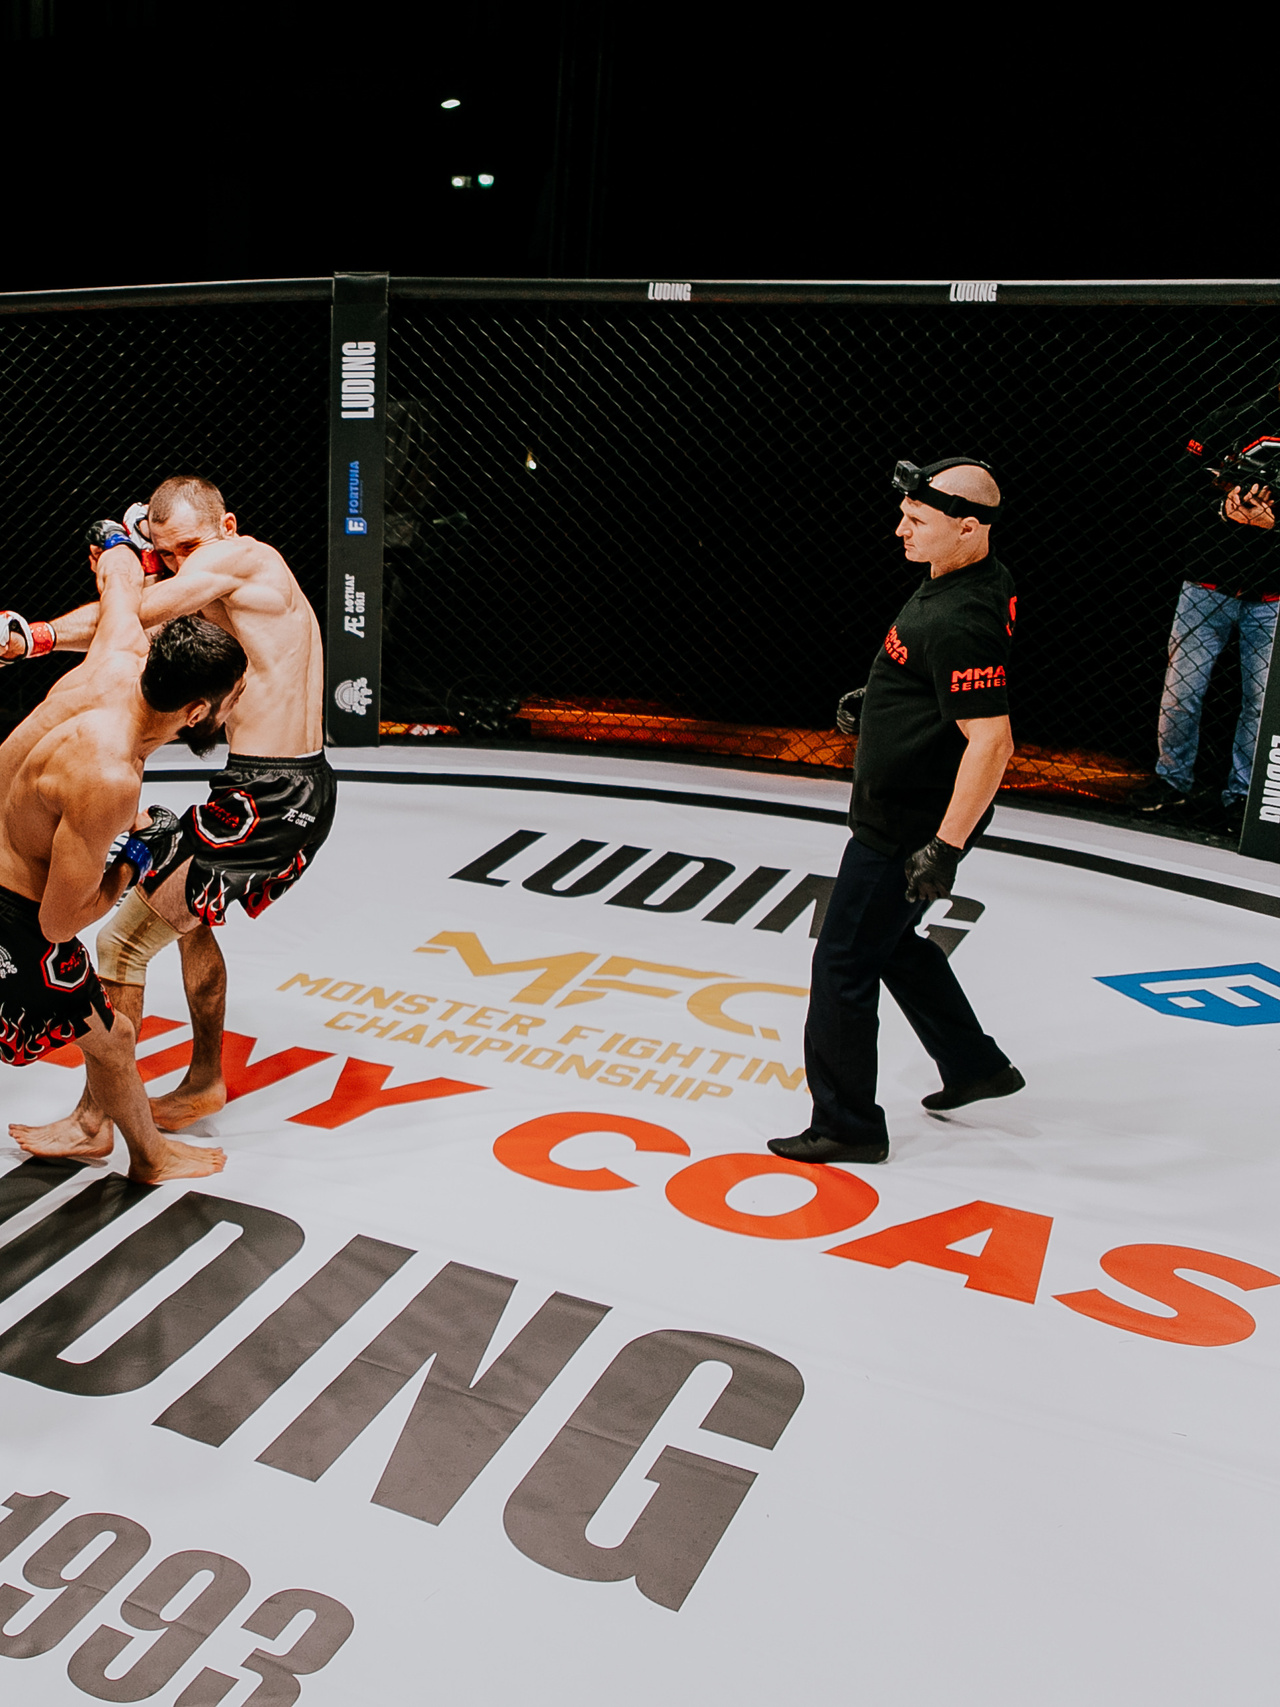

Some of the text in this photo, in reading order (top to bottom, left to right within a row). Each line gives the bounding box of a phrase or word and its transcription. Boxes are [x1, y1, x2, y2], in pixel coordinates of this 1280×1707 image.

[648, 282, 691, 301] LUDING
[950, 283, 998, 302] LUDING
[341, 341, 376, 419] LUDING
[950, 678, 1006, 692] SERIES
[951, 665, 1006, 683] MMA
[413, 930, 812, 1042] MFC
[276, 972, 812, 1095] MONSTER FIGHTIN
[323, 1010, 734, 1102] CHAMPIONSHIP
[493, 1111, 1280, 1347] COAS
